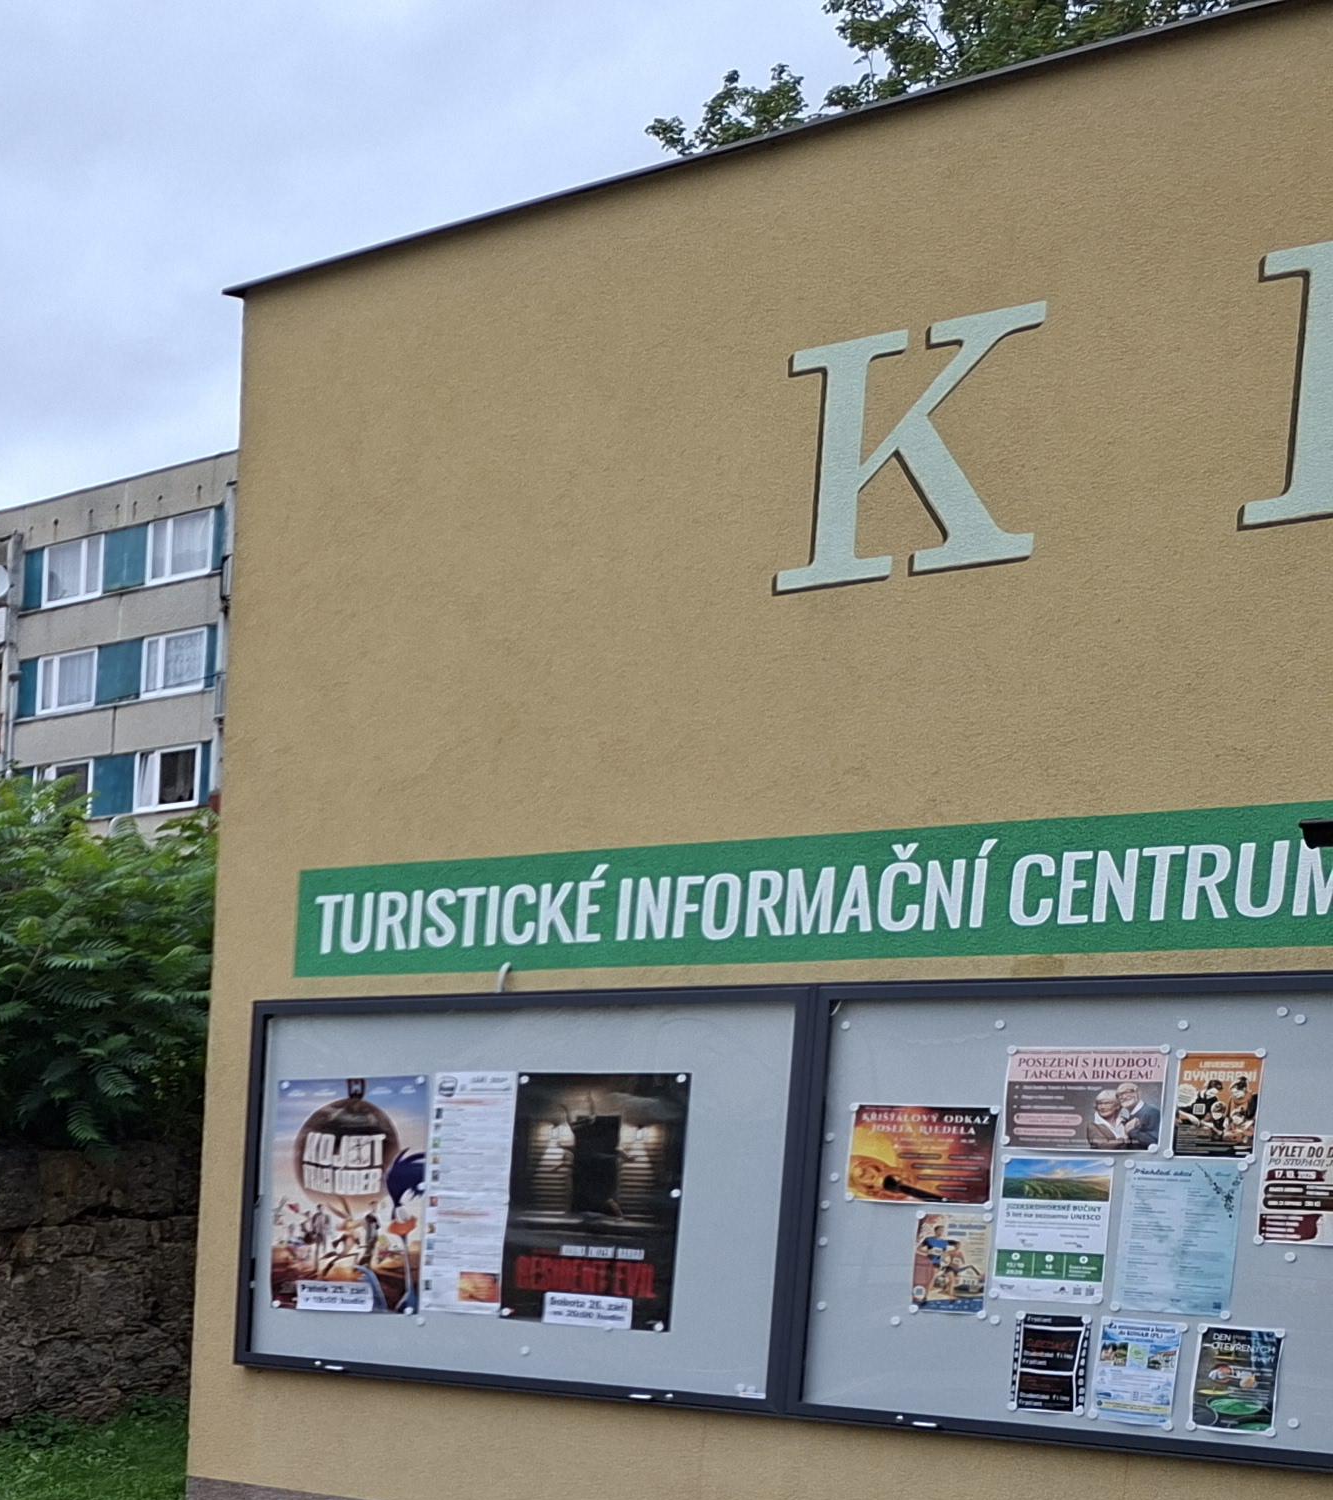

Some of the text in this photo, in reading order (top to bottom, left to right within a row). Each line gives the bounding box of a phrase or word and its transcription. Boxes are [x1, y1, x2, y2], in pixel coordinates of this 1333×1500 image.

[315, 864, 610, 955] TURISTICKÉ
[615, 839, 999, 942] INFORMAČNÍ
[1018, 1055, 1161, 1069] POSEZENÍ S HUDBOU,
[1023, 1069, 1076, 1080] TANCEM
[1092, 1069, 1154, 1081] BINGEM!
[943, 1114, 990, 1125] ODKAZ
[1269, 1143, 1305, 1158] VÝLET
[1213, 1332, 1232, 1342] DEN
